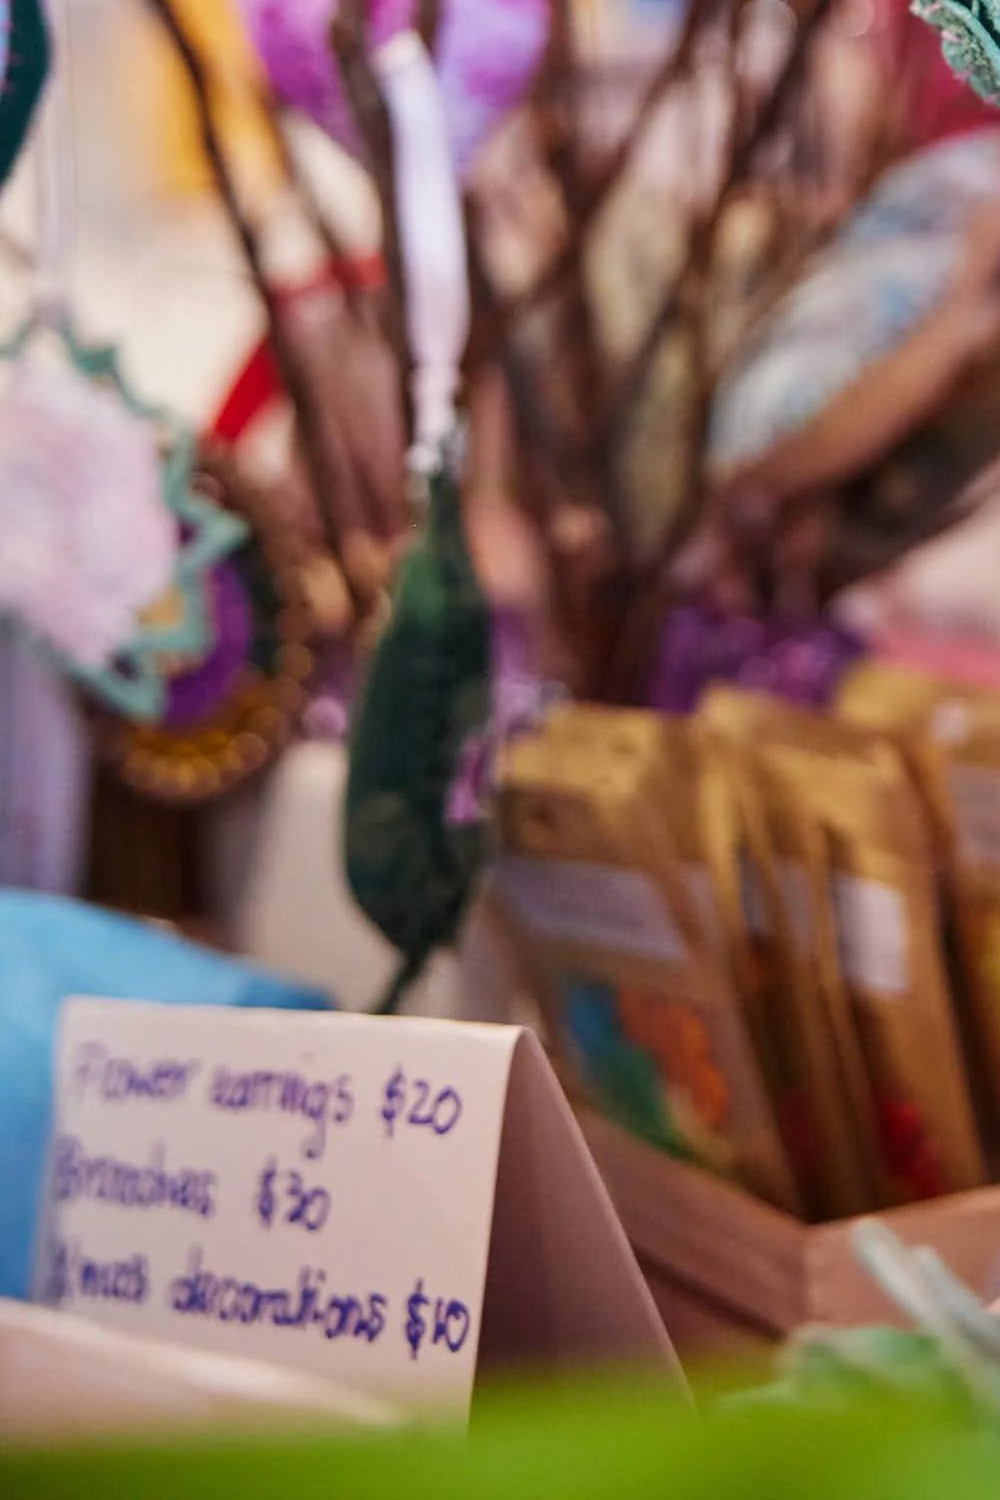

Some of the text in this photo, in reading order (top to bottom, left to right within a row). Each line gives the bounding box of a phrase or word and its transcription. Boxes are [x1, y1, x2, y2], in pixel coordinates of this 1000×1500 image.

[381, 1063, 463, 1138] $20
[172, 1245, 387, 1343] decorations
[404, 1277, 470, 1361] $10
